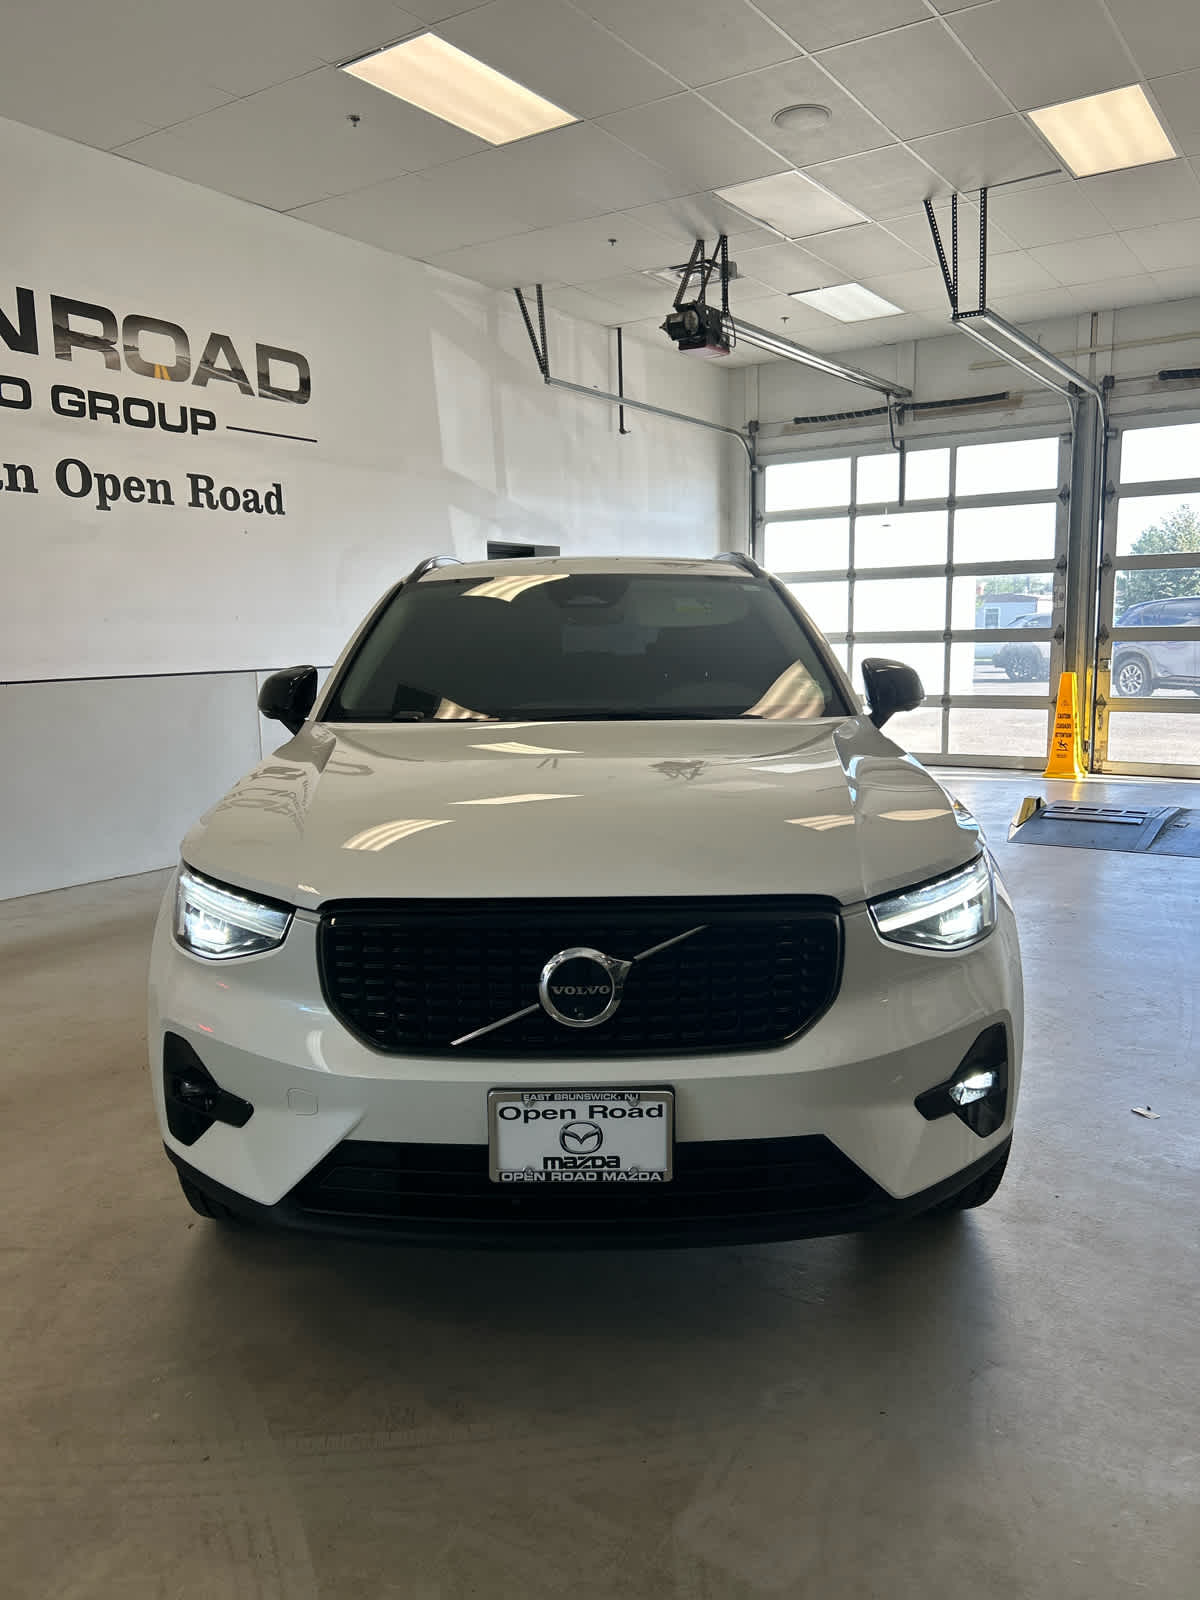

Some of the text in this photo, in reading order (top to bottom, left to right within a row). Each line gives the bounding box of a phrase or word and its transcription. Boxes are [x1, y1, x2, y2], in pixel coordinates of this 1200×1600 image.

[50, 385, 216, 435] GROUP
[55, 458, 174, 511] Open
[186, 473, 285, 515] Road
[551, 985, 611, 995] VOLVO
[523, 1093, 551, 1101] EAST
[624, 1092, 639, 1101] NJ
[499, 1104, 663, 1124] Open Road
[501, 1171, 662, 1182] OPEN ROAD MAZDA
